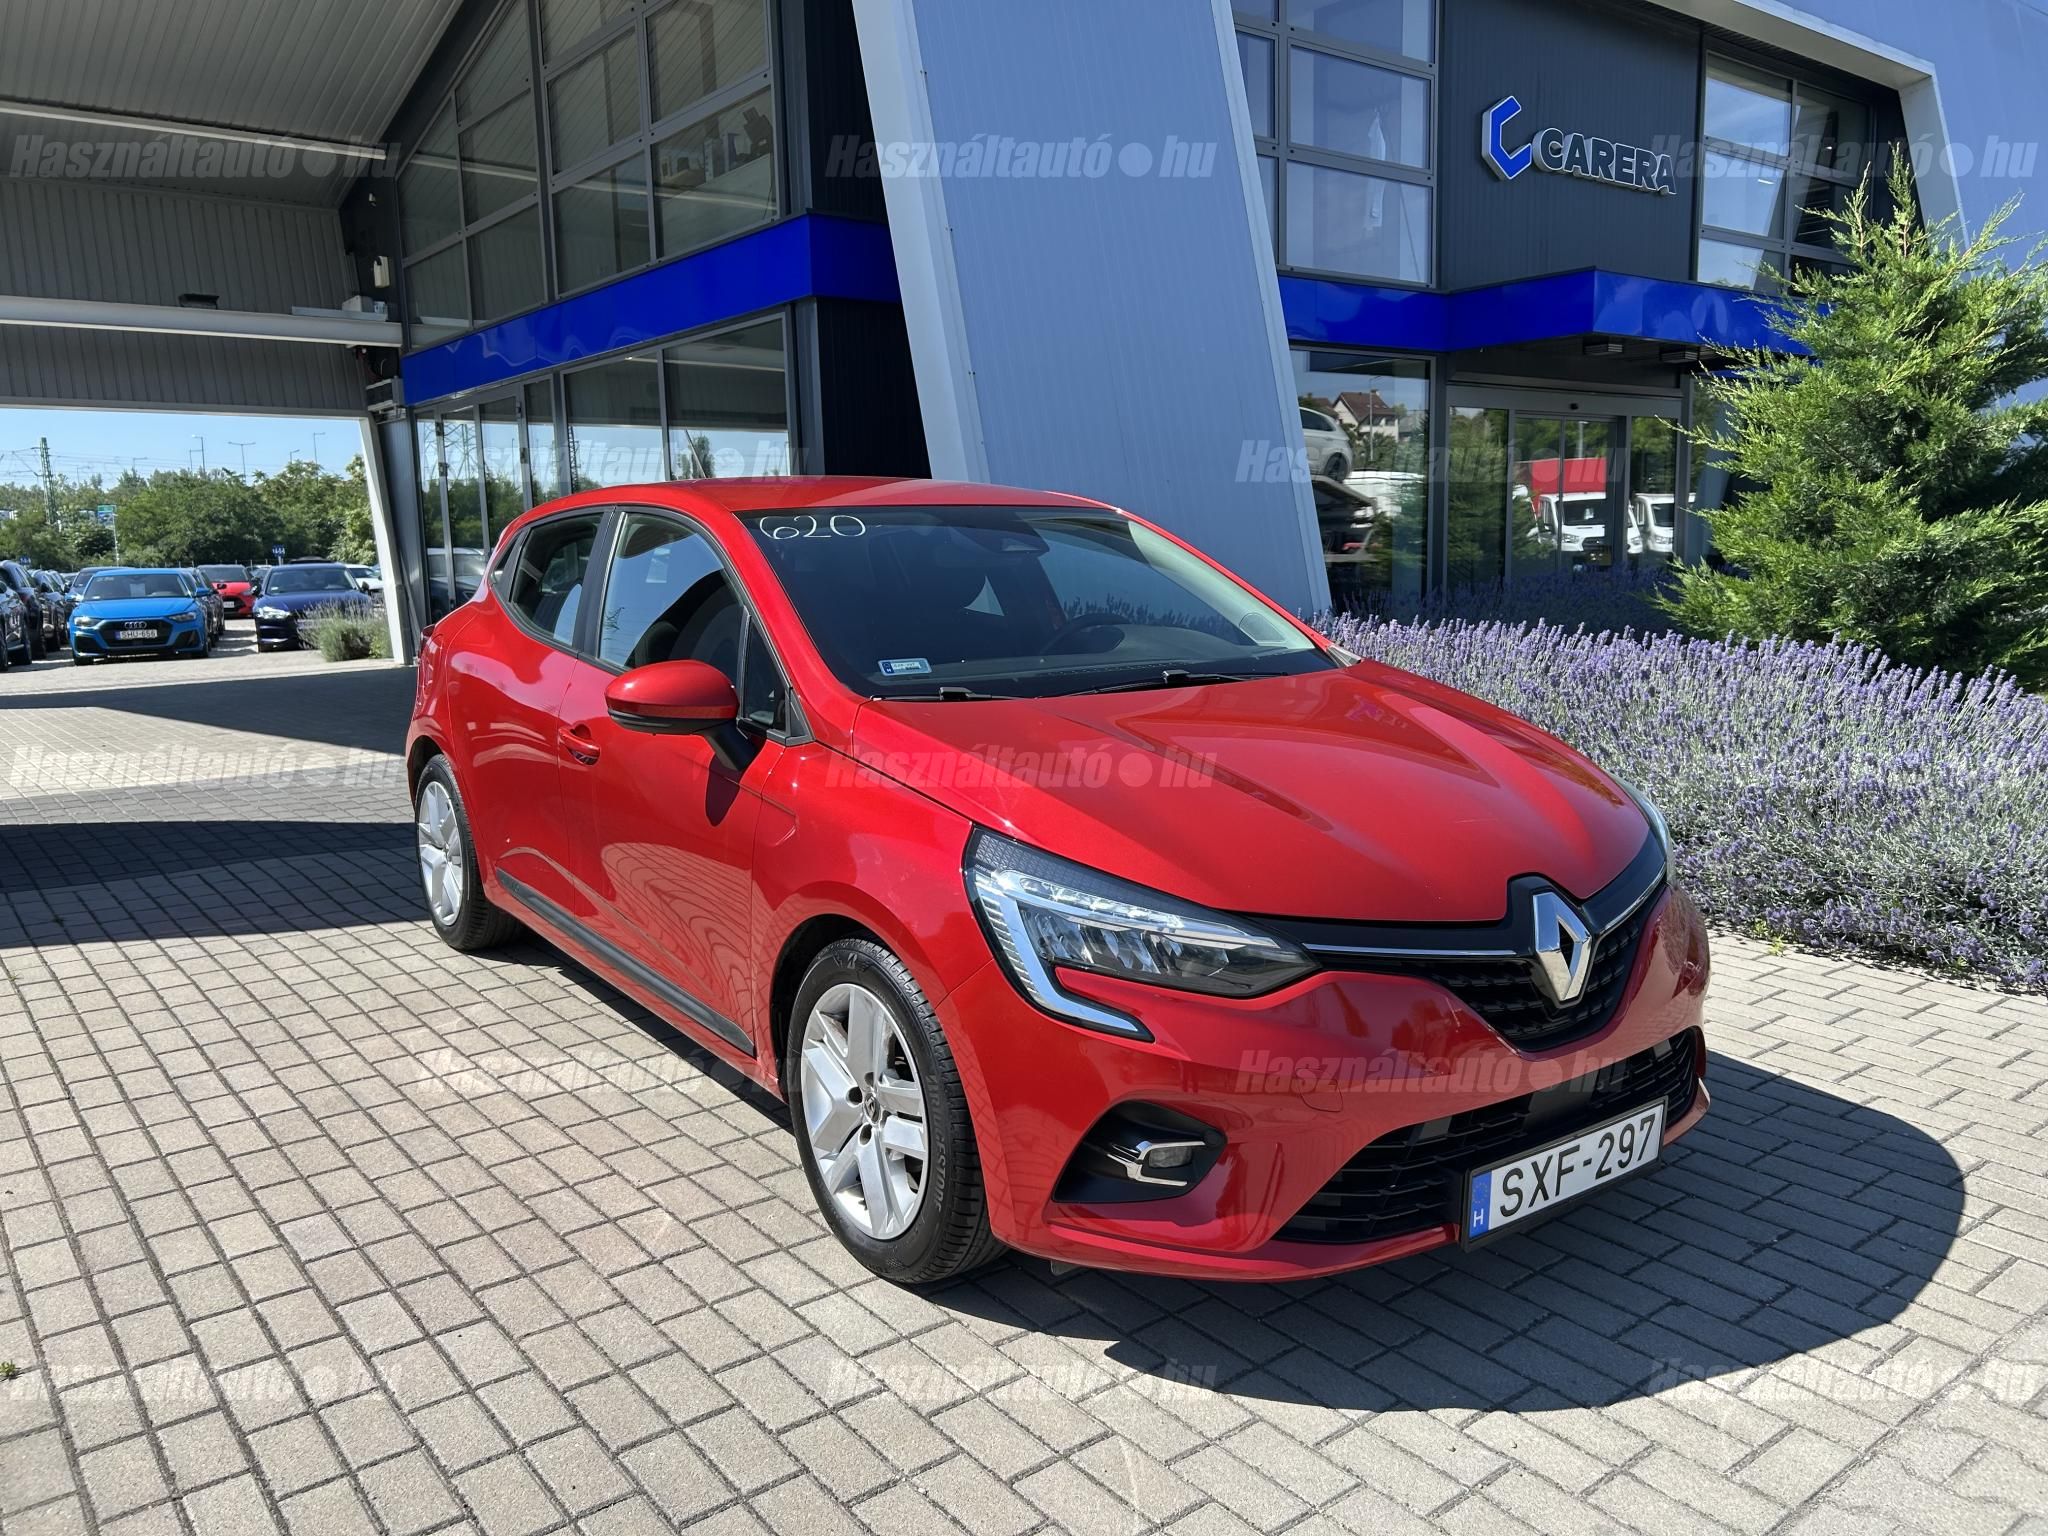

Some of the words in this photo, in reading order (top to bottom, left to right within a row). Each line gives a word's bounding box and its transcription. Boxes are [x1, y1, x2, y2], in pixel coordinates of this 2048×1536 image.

[1534, 128, 1677, 194] CARERA
[760, 515, 865, 539] 620
[1500, 1113, 1655, 1217] SXF-297
[1473, 1208, 1484, 1227] H
